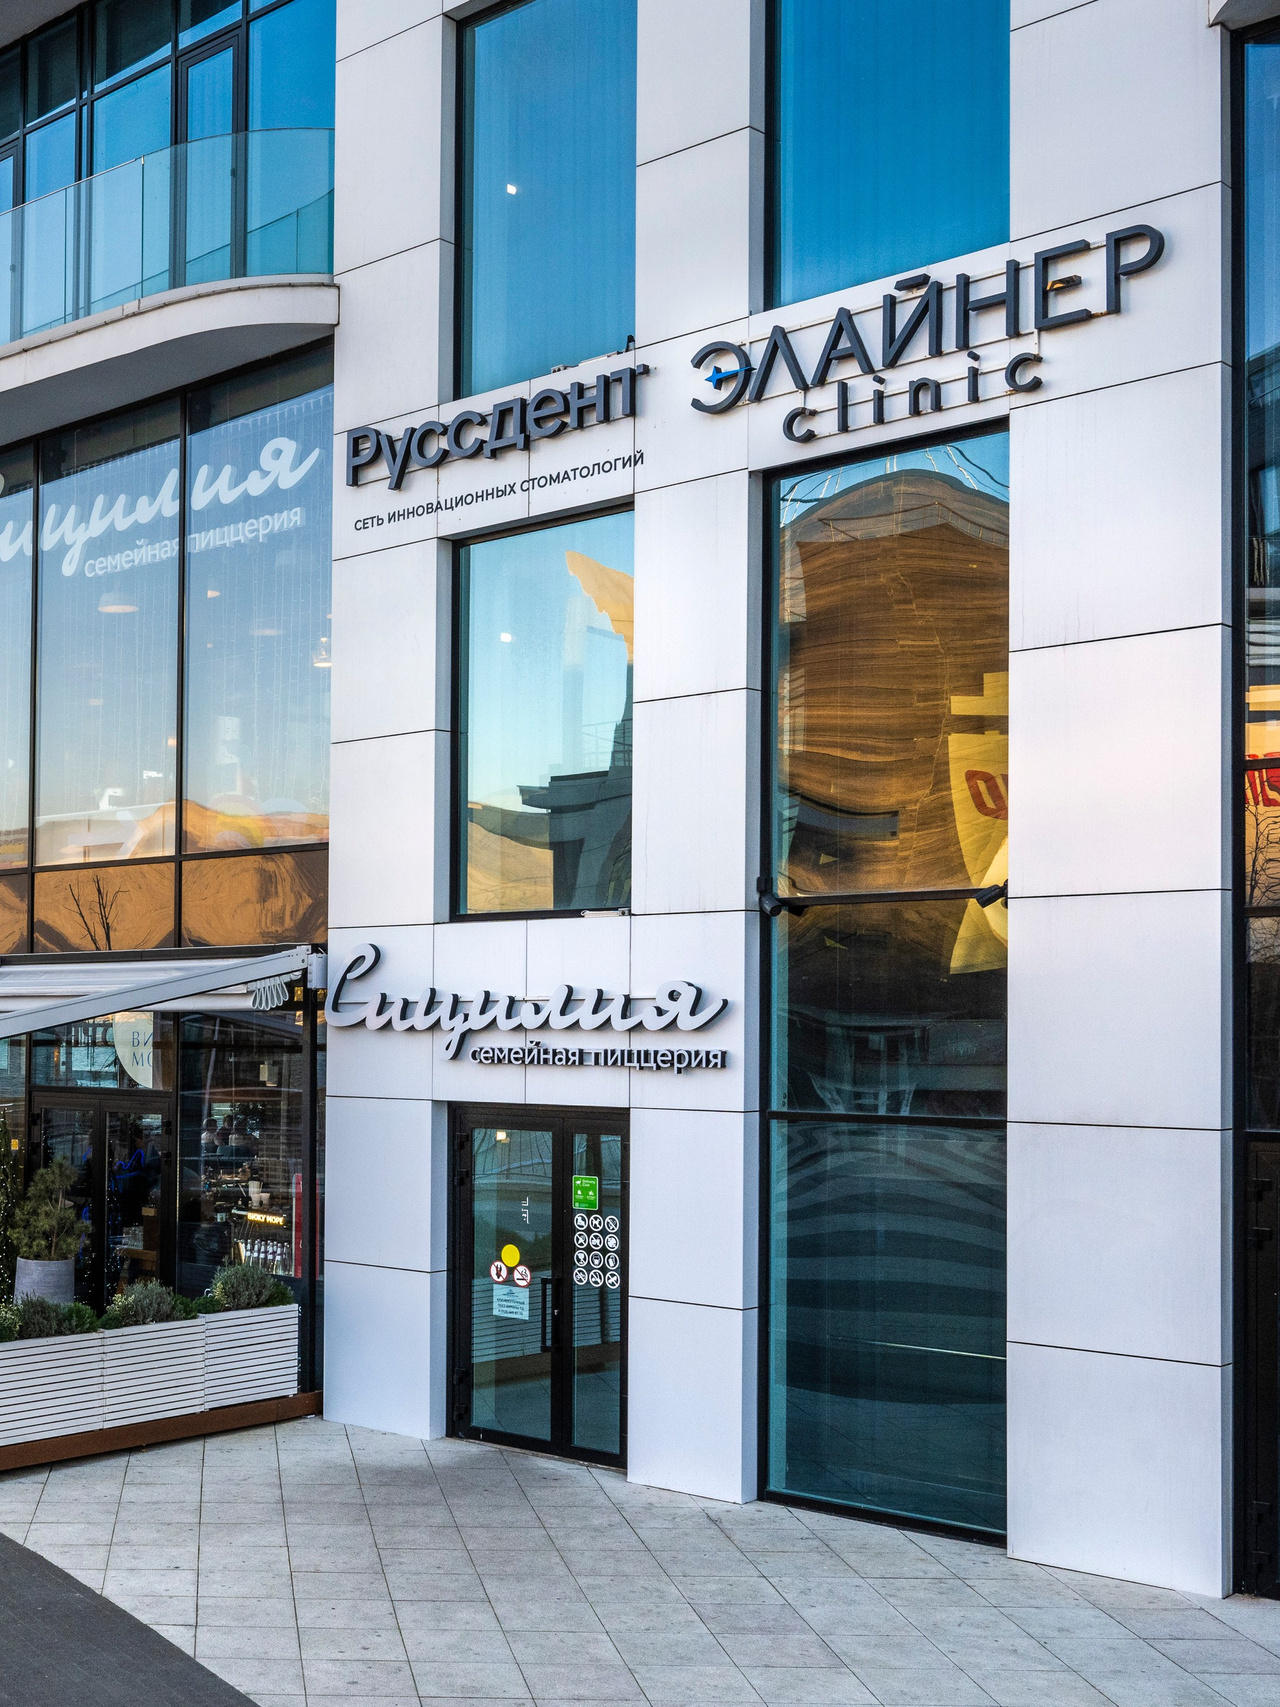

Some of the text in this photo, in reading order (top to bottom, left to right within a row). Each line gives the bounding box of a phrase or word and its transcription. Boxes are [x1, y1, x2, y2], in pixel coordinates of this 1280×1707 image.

[690, 224, 1165, 414] ЭЛАЙНЕР
[346, 363, 650, 491] Руссдент
[782, 351, 1043, 443] clinic
[354, 450, 645, 532] СЕТЬ ИННОВАЦИОННЫХ СТОМАТОЛОГИЙ
[84, 506, 303, 578] семейная пиццерия
[324, 943, 728, 1060] Сицилия
[469, 1040, 727, 1074] семейная пиццерия
